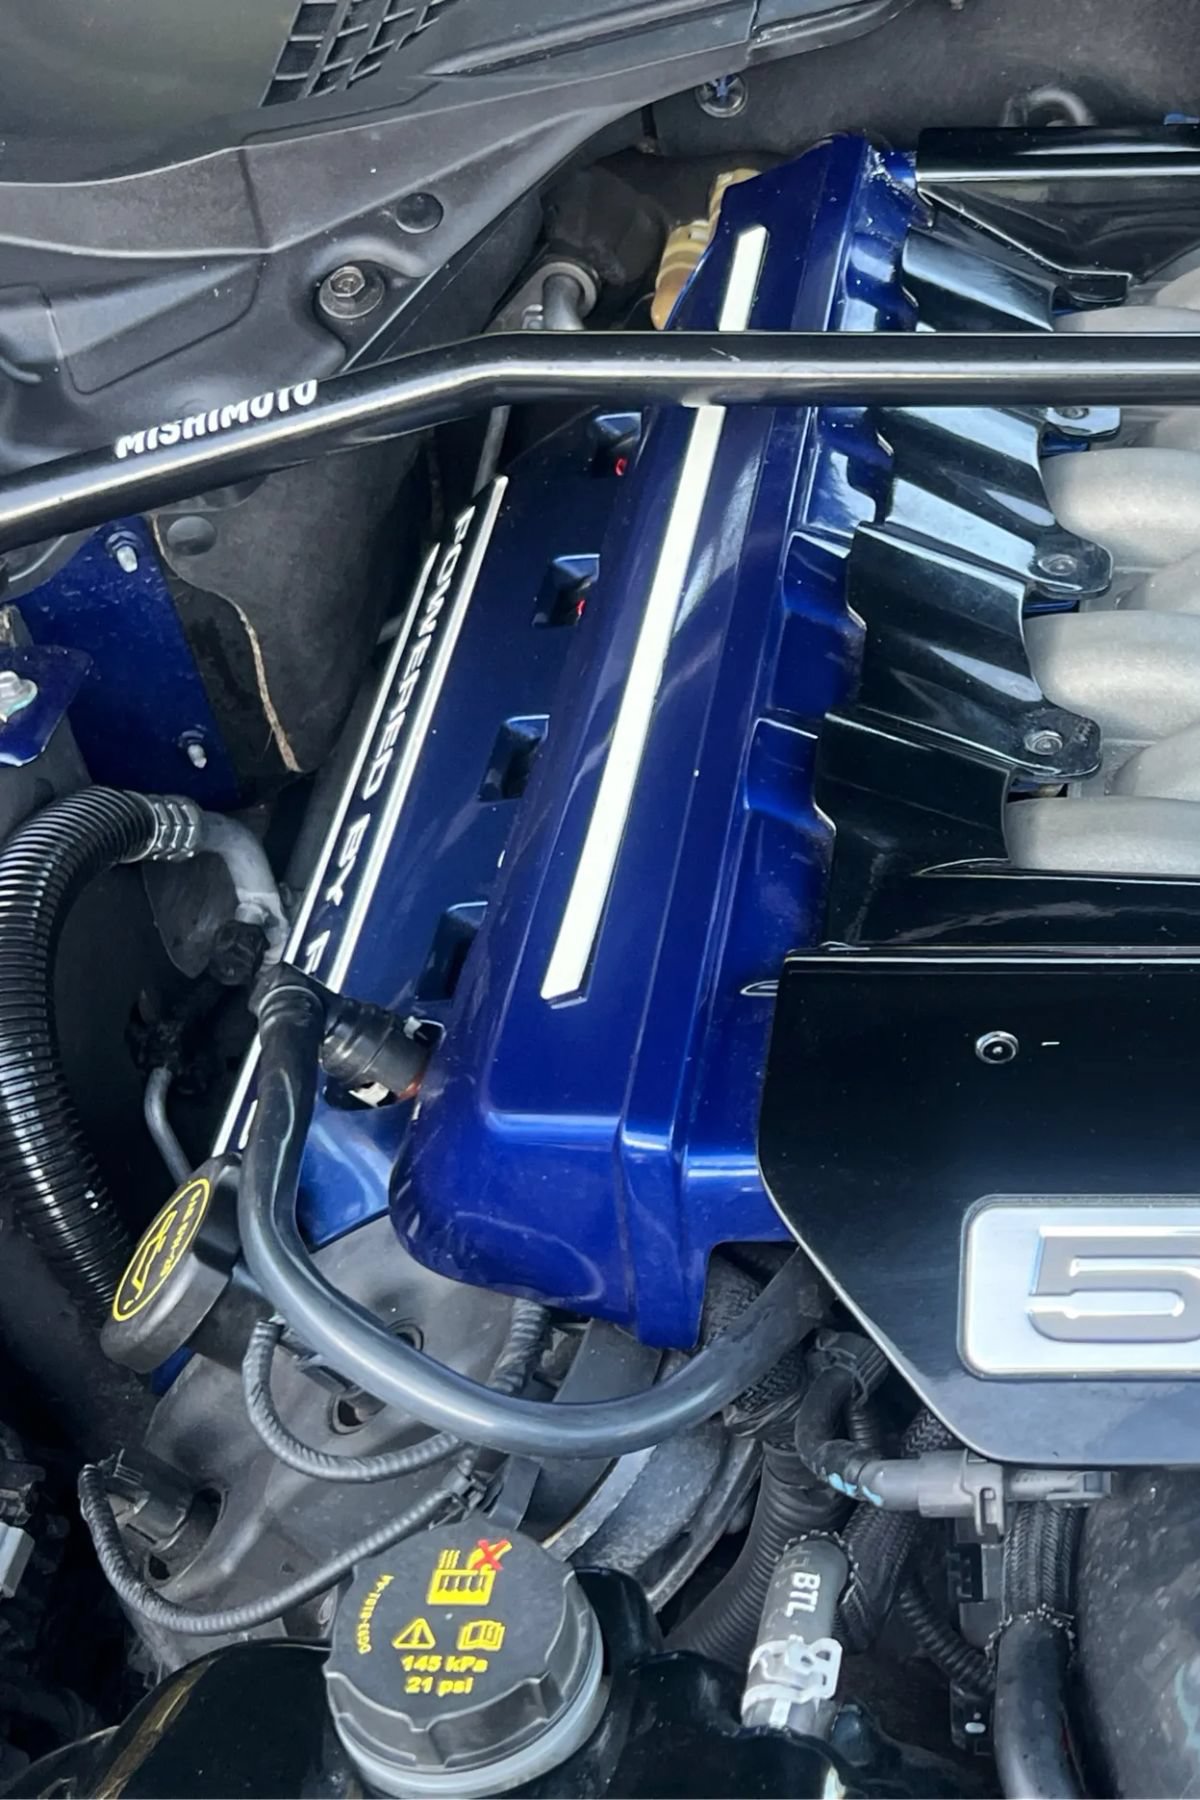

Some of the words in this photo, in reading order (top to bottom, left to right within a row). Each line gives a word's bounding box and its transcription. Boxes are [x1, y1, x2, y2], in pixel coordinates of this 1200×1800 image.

[114, 379, 318, 459] MISHIMOTO
[362, 505, 476, 800] POWERED
[326, 813, 371, 906] BY
[785, 1572, 820, 1617] BTL
[401, 1655, 442, 1673] 145
[445, 1655, 489, 1673] kPa
[405, 1676, 434, 1694] 21
[437, 1676, 474, 1697] psi
